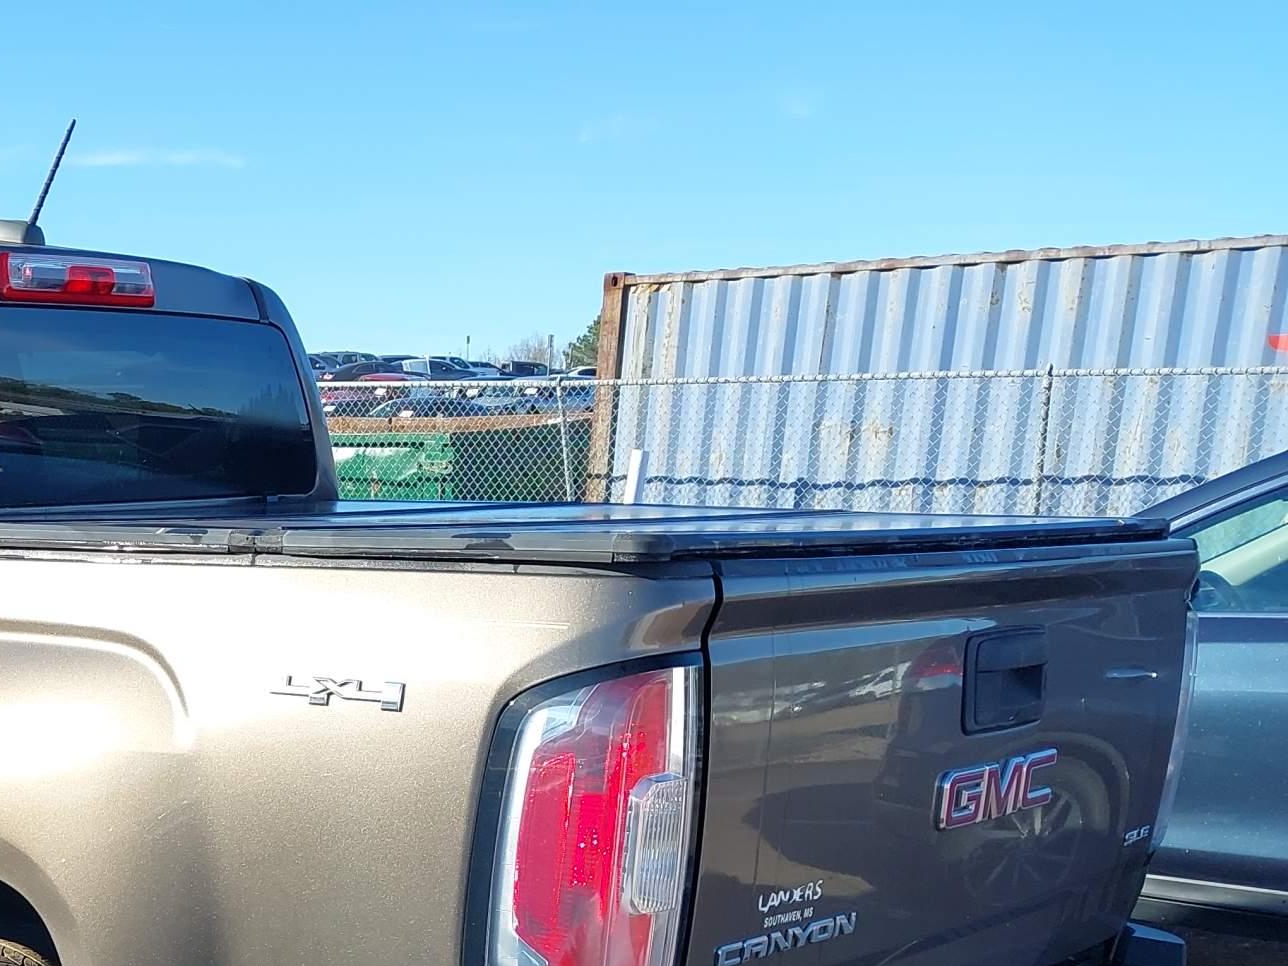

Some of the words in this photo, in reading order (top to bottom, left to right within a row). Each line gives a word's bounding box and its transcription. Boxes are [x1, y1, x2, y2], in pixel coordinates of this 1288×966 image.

[934, 748, 1058, 831] GMC
[758, 879, 825, 914] LANDERS
[763, 909, 803, 929] SOUTHAVEN,
[803, 906, 815, 919] MS
